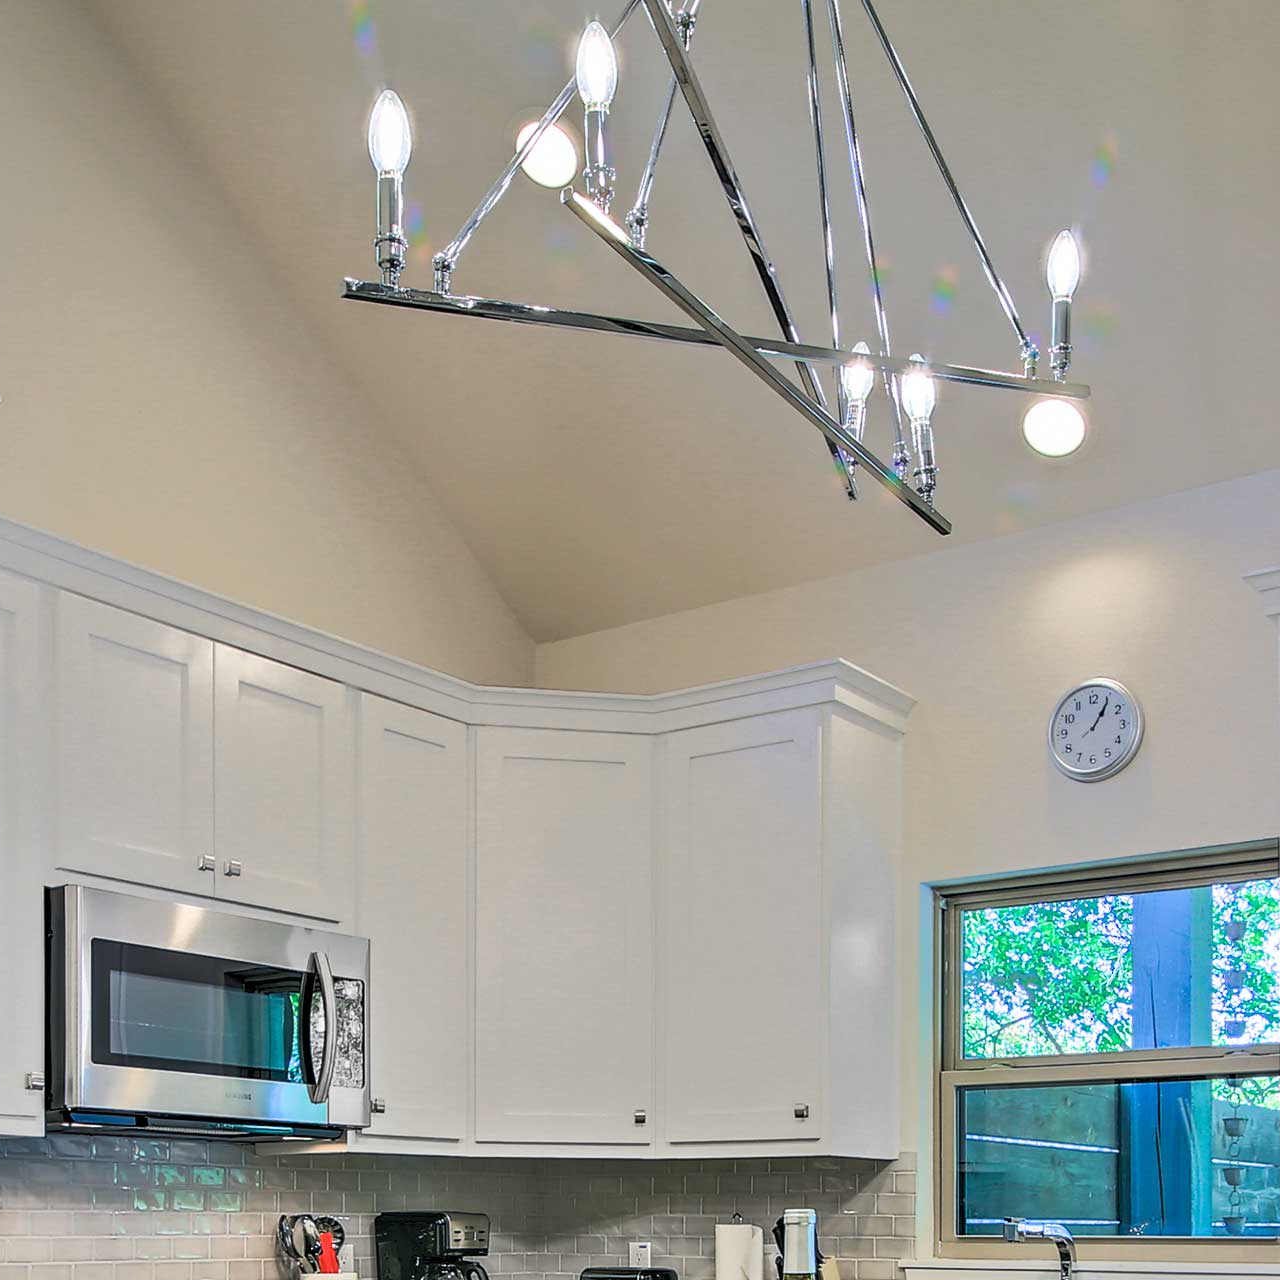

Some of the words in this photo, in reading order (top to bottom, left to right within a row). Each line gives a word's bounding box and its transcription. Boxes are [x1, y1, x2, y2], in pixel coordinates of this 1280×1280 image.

[1089, 694, 1099, 705] 12
[1115, 704, 1122, 715] 2
[1064, 714, 1075, 724] 10
[1120, 719, 1126, 730] 3
[1061, 729, 1068, 739] 9
[1115, 736, 1121, 745] 4
[1065, 744, 1072, 753] 8
[1104, 748, 1111, 758] 5
[1077, 753, 1082, 762] 7
[1089, 755, 1096, 764] 6
